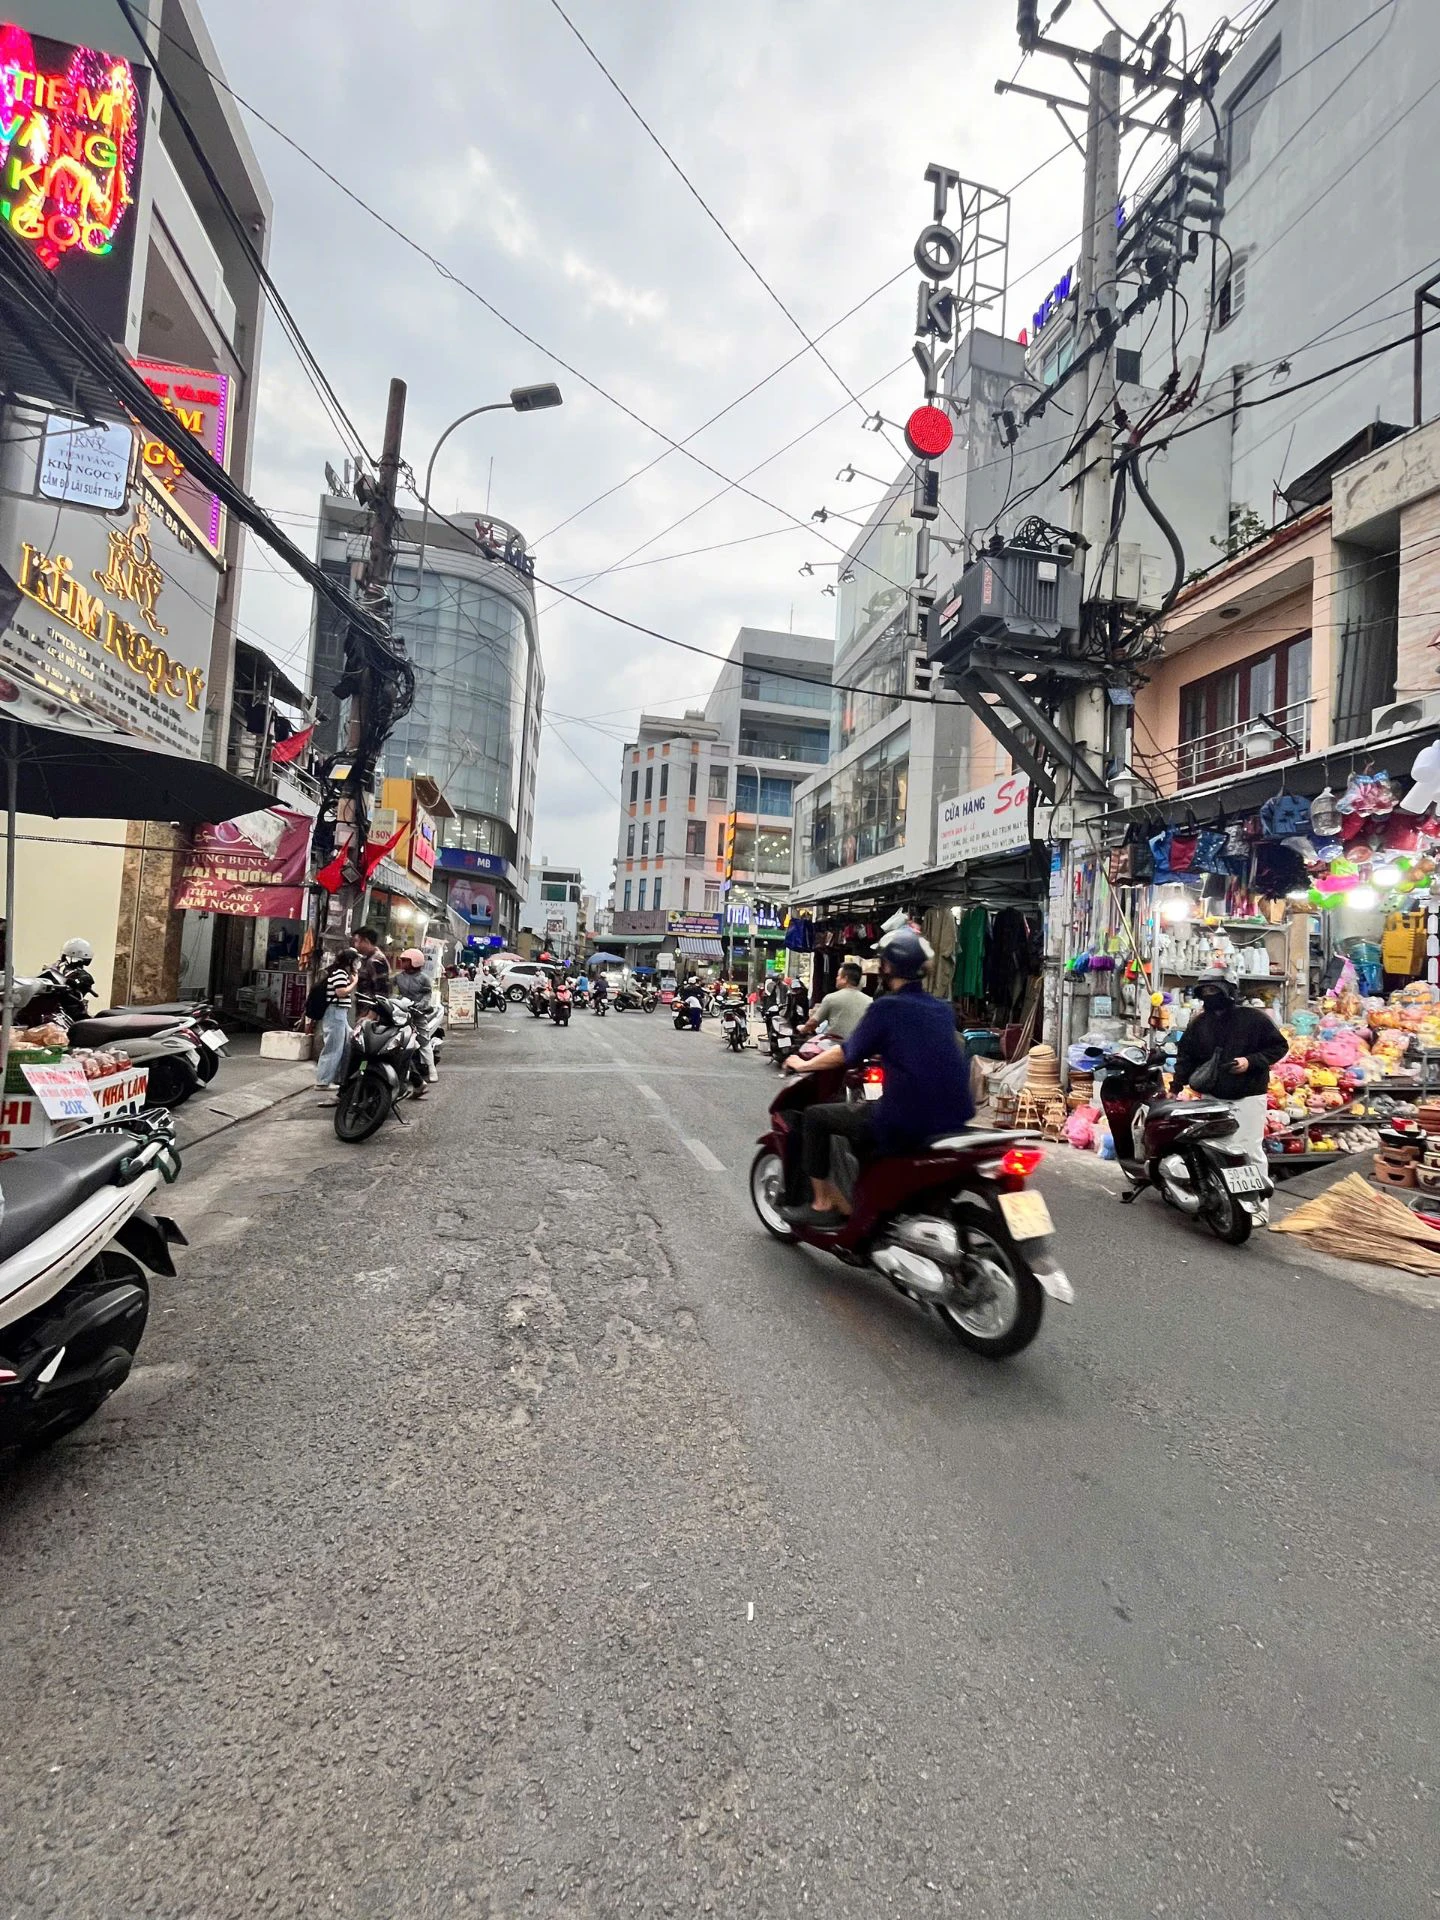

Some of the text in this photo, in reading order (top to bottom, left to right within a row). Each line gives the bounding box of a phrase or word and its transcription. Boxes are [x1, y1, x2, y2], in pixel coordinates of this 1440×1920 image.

[48, 459, 72, 472] KIM
[75, 465, 111, 481] NGỌC
[962, 795, 986, 816] HÀNG
[477, 857, 491, 869] MB
[177, 896, 207, 908] KIM
[209, 898, 250, 914] NGỌC
[102, 1078, 125, 1108] NHÀ
[60, 1100, 88, 1115] 20K
